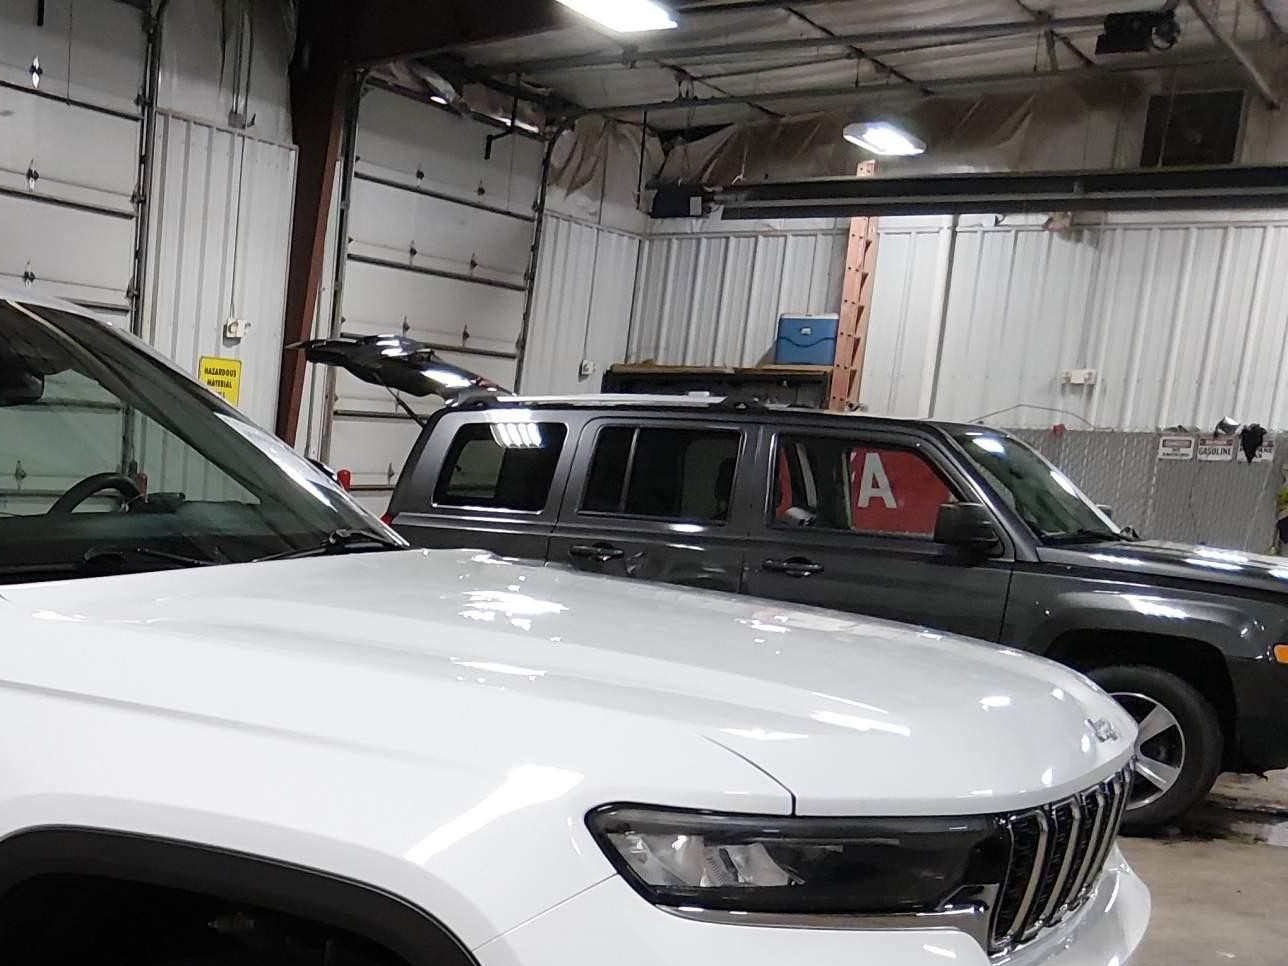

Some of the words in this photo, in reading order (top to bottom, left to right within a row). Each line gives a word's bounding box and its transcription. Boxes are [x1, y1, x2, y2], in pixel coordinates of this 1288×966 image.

[204, 367, 237, 378] HAZARDOUS
[207, 379, 232, 388] MATERIAL
[1198, 447, 1231, 456] GASOLINE
